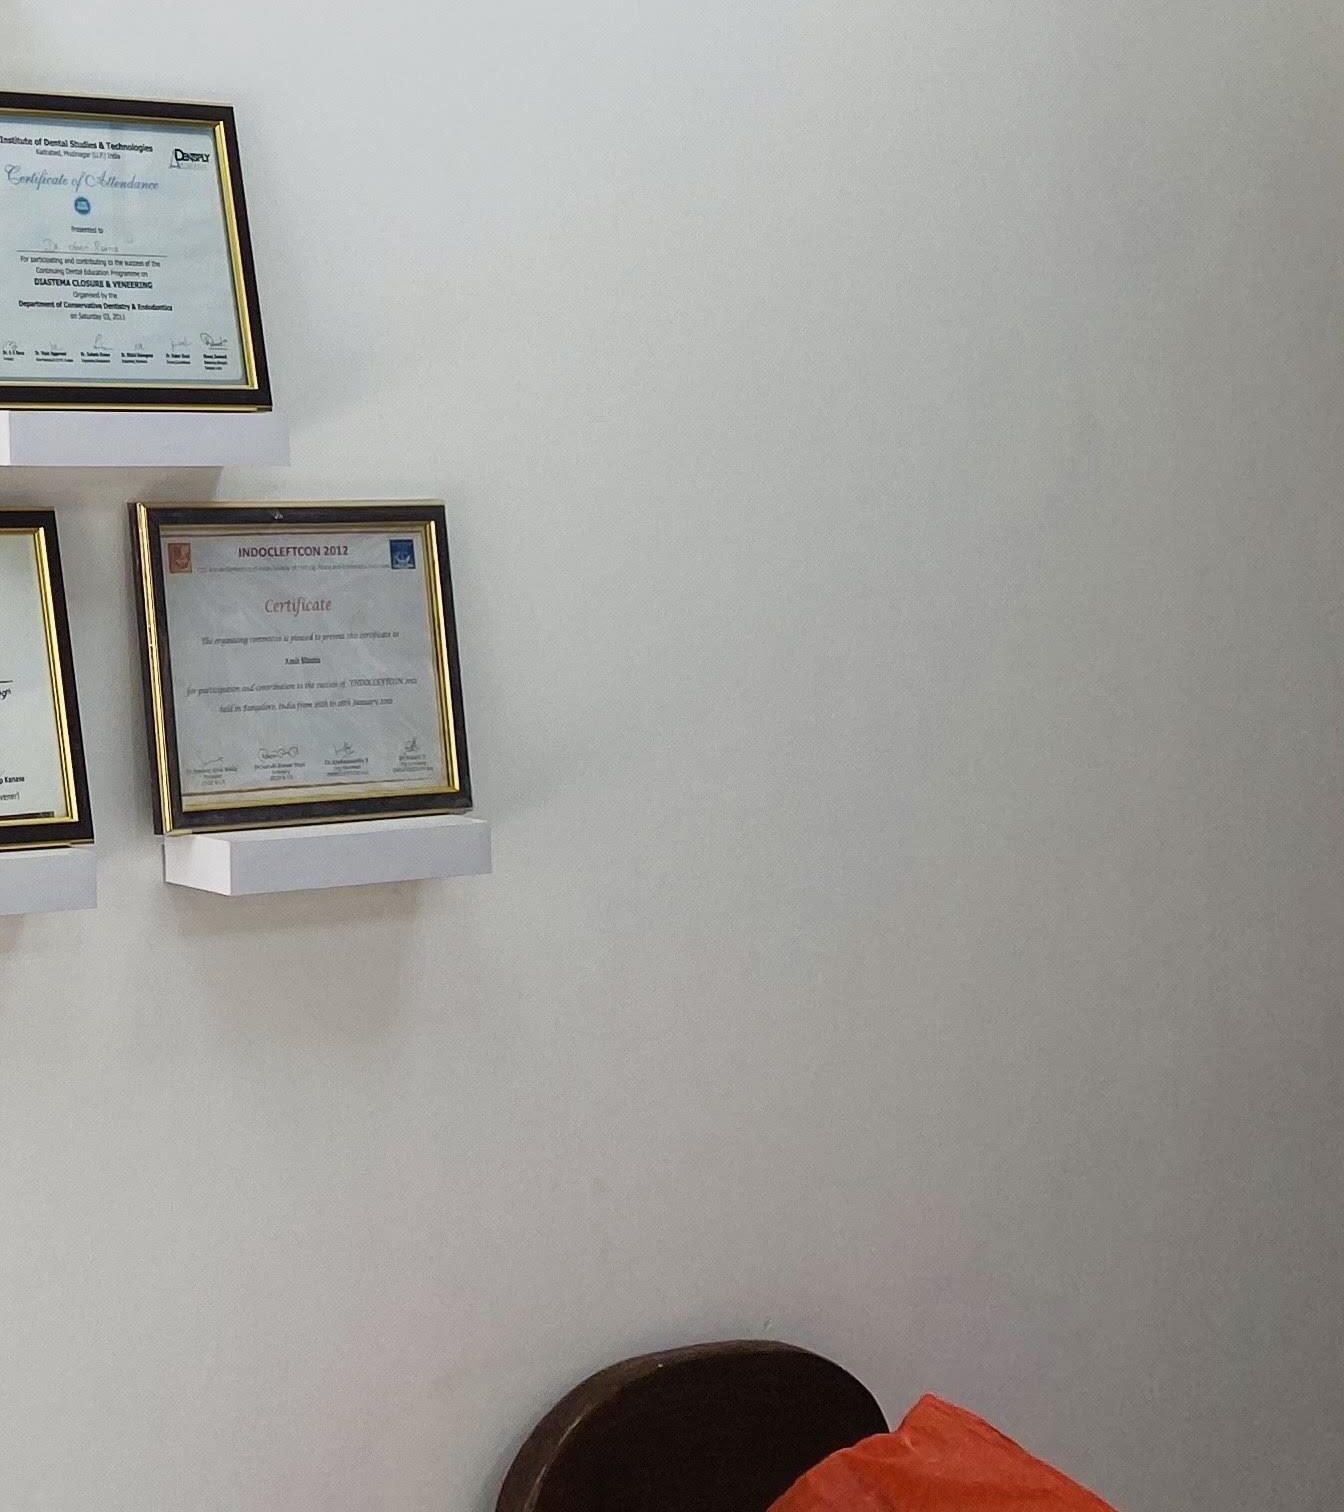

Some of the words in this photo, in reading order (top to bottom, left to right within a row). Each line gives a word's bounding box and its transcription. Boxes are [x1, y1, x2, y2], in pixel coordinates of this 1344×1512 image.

[0, 137, 32, 145] Institute
[34, 139, 43, 147] of
[44, 139, 68, 147] Dental
[70, 140, 97, 148] Studies
[106, 143, 153, 152] Technologies
[4, 164, 68, 190] Certificate
[71, 174, 83, 192] of
[85, 171, 159, 190] Attendance
[238, 546, 321, 557] INDOCLEFTCON
[324, 546, 348, 556] 2012
[264, 597, 332, 617] Certificate
